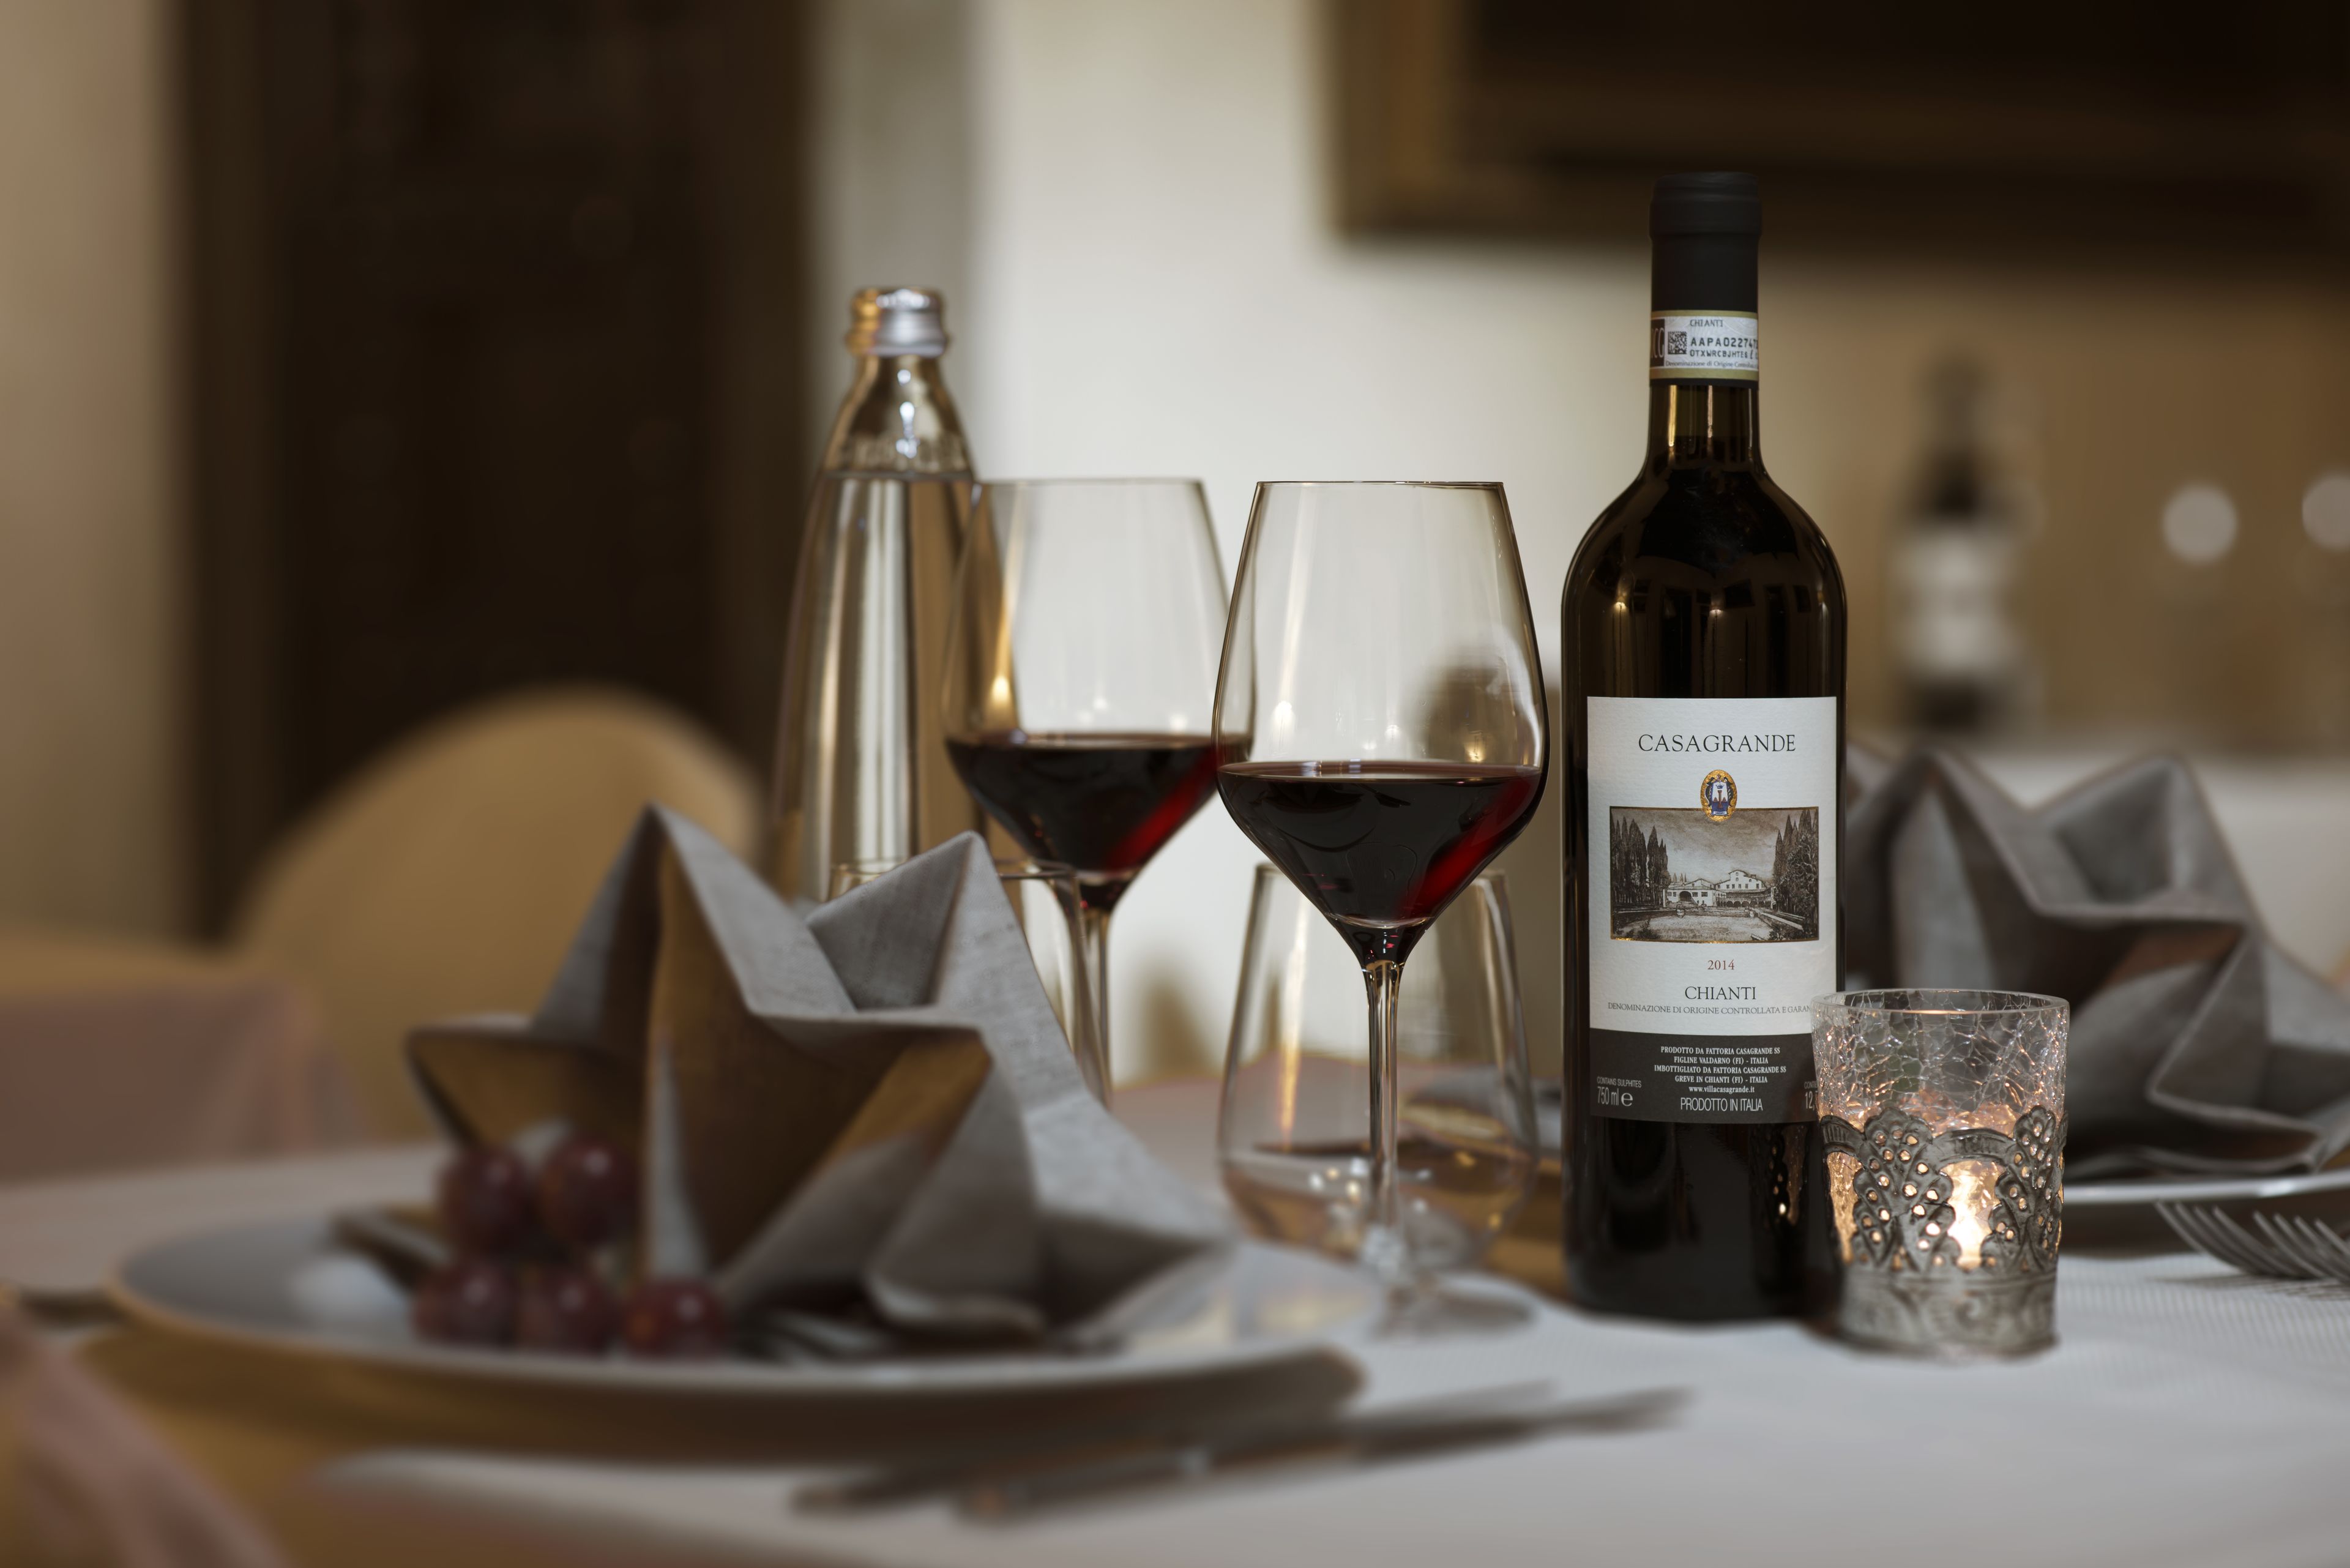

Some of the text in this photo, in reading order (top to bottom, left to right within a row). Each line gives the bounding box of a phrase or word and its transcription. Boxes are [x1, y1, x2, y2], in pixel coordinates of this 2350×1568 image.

[1638, 734, 1796, 752] CASAGRANDE
[1707, 959, 1735, 970] 2014
[1685, 986, 1756, 1000] CHIANTI
[1608, 1002, 1671, 1014] DENOMINAZIONE
[1733, 1056, 1744, 1065] (FI)
[1654, 1064, 1701, 1073] IMBOTTIGLIATO
[1597, 1076, 1641, 1088] CONTAINS SULPHITES
[1688, 1085, 1755, 1094] www.villacasagrande.it
[1597, 1086, 1610, 1105] 750
[1611, 1088, 1619, 1106] ml
[1680, 1097, 1763, 1111] PRODOTTO IN ITALIA
